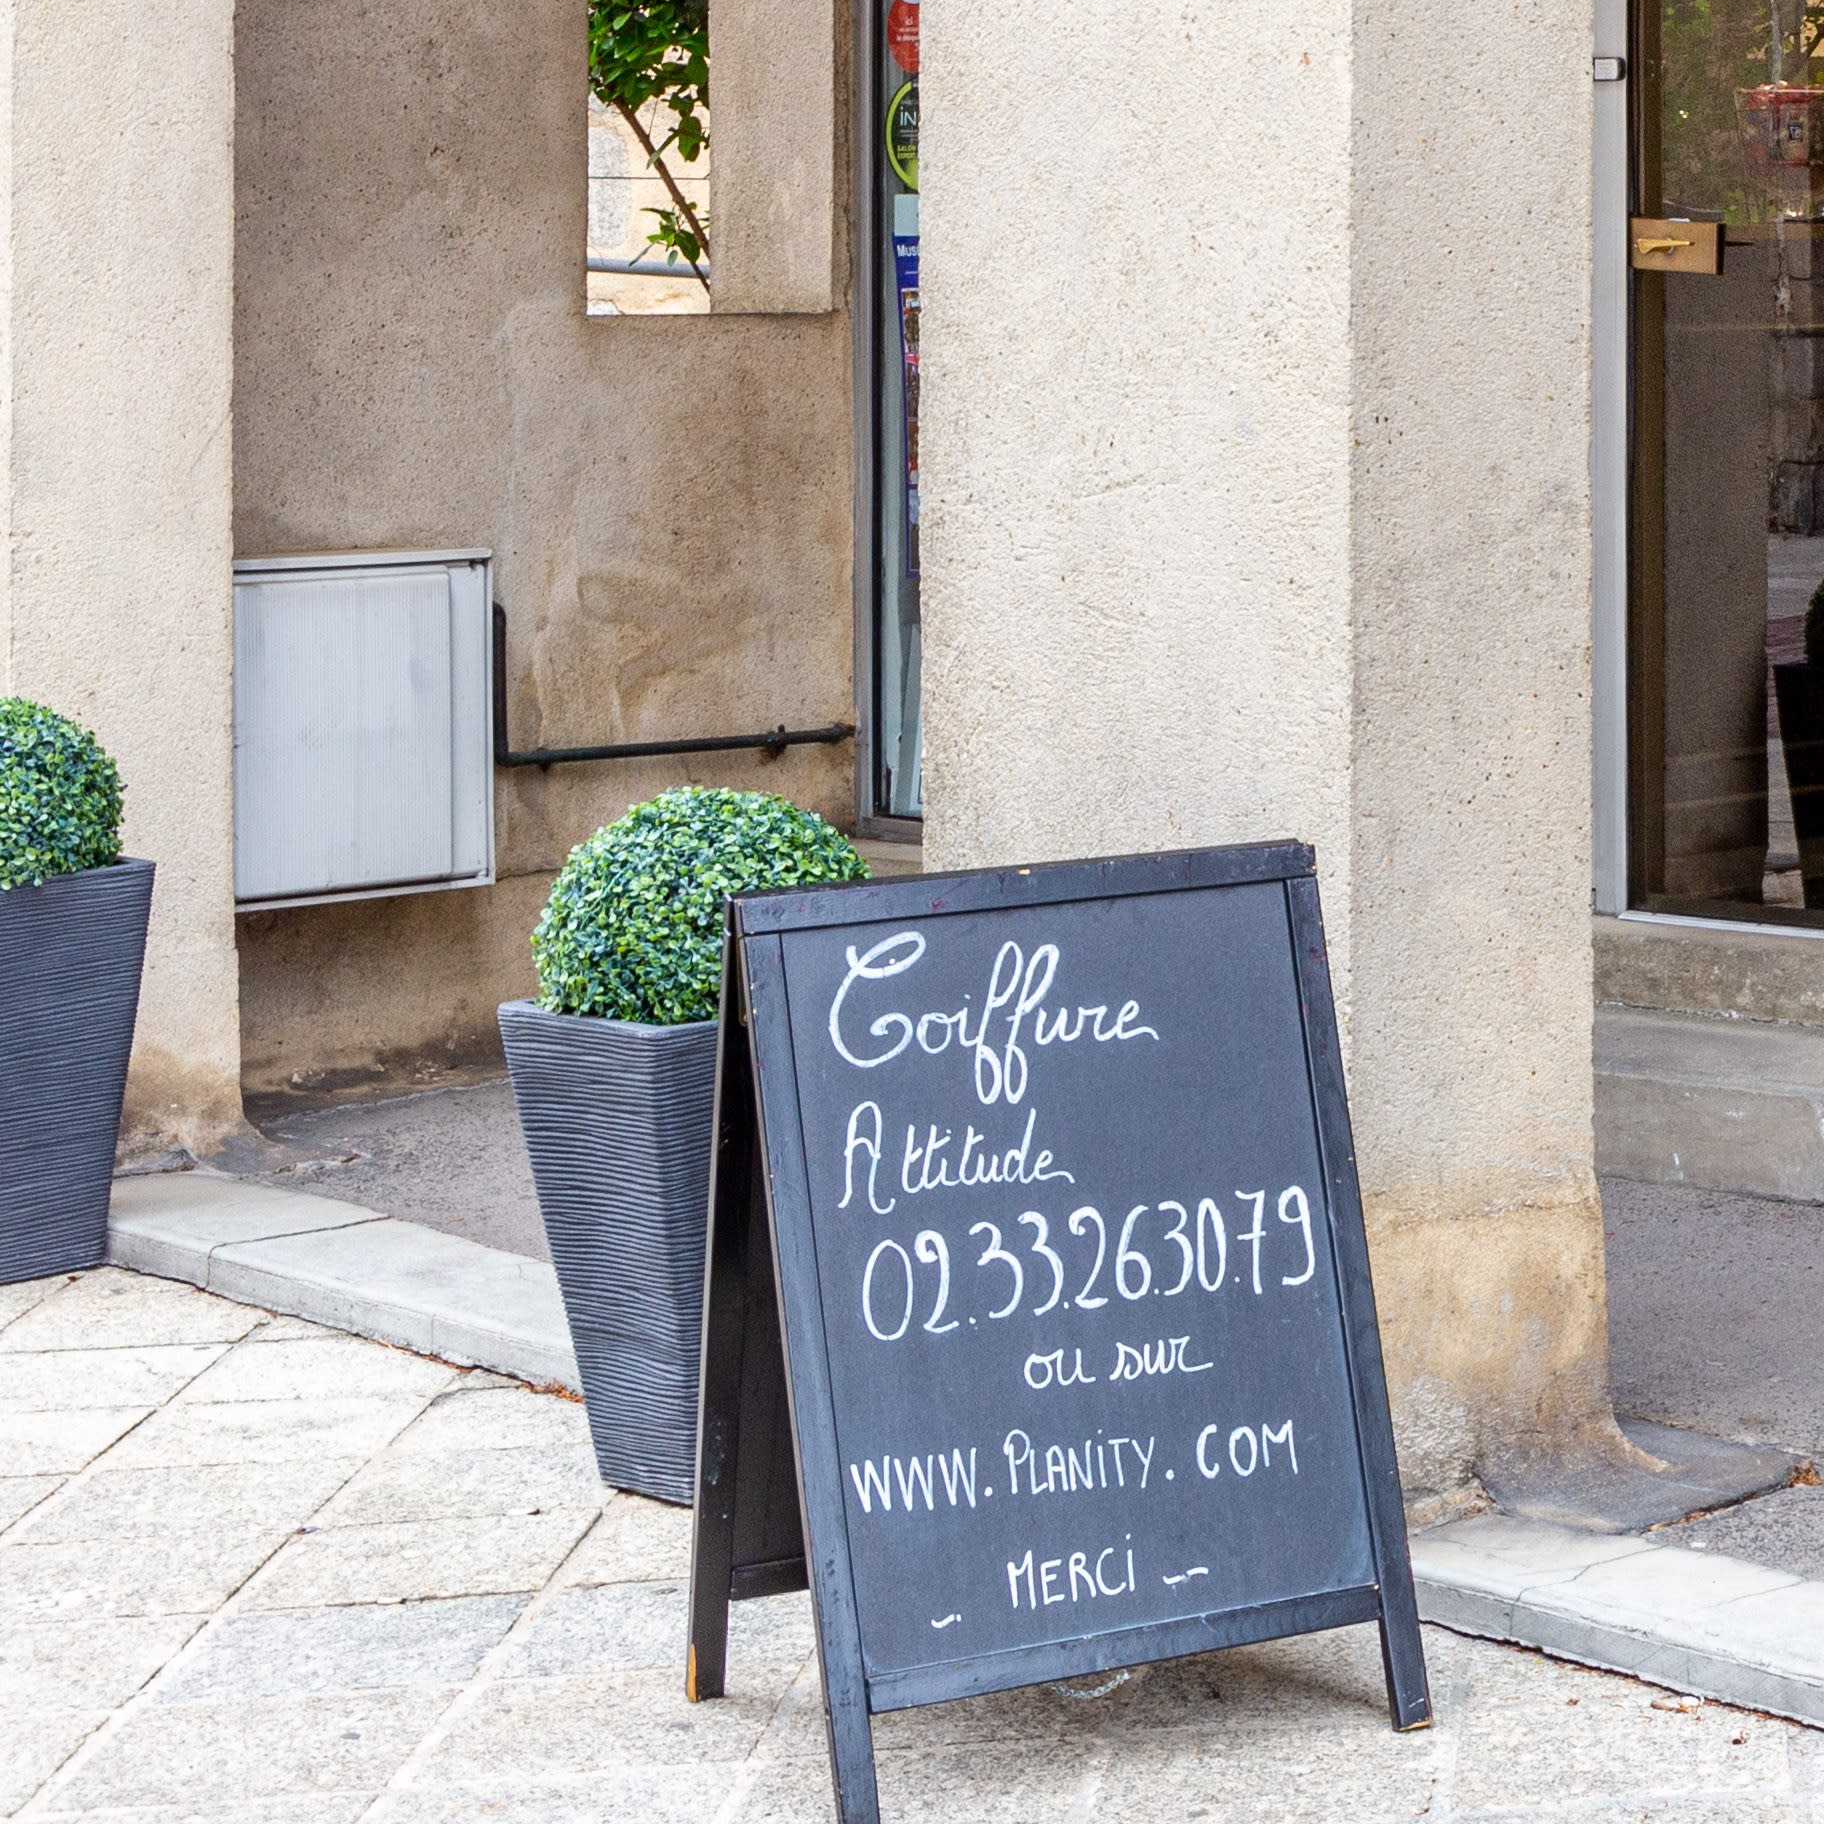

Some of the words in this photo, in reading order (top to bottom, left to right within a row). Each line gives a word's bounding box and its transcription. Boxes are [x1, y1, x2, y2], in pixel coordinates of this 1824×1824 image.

[829, 930, 1159, 1104] Coiffure
[838, 1100, 1074, 1214] Attitude
[1024, 1344, 1097, 1390] ou
[1110, 1335, 1214, 1380] sur
